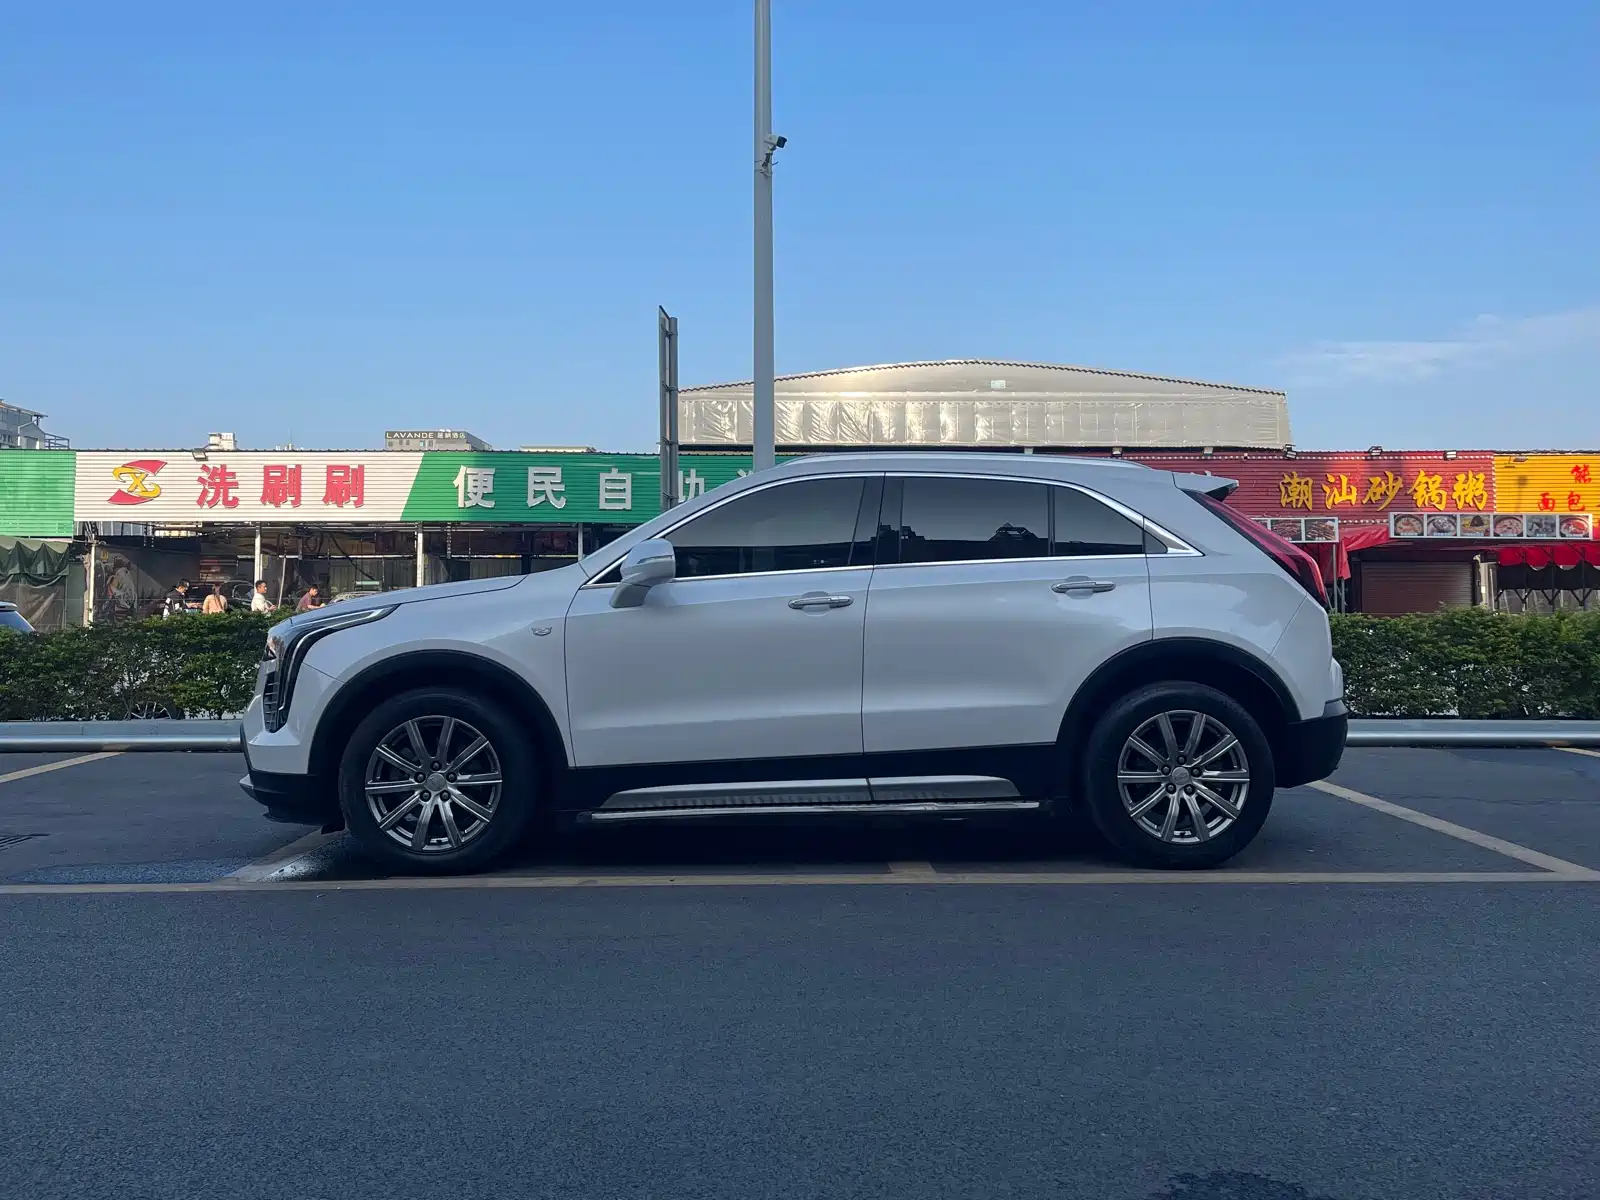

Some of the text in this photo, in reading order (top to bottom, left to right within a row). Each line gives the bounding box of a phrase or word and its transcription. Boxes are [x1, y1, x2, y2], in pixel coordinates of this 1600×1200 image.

[196, 464, 365, 509] 洗刷刷
[1279, 469, 1489, 511] 潮汕砂锅粥
[1537, 491, 1600, 512] 面包
